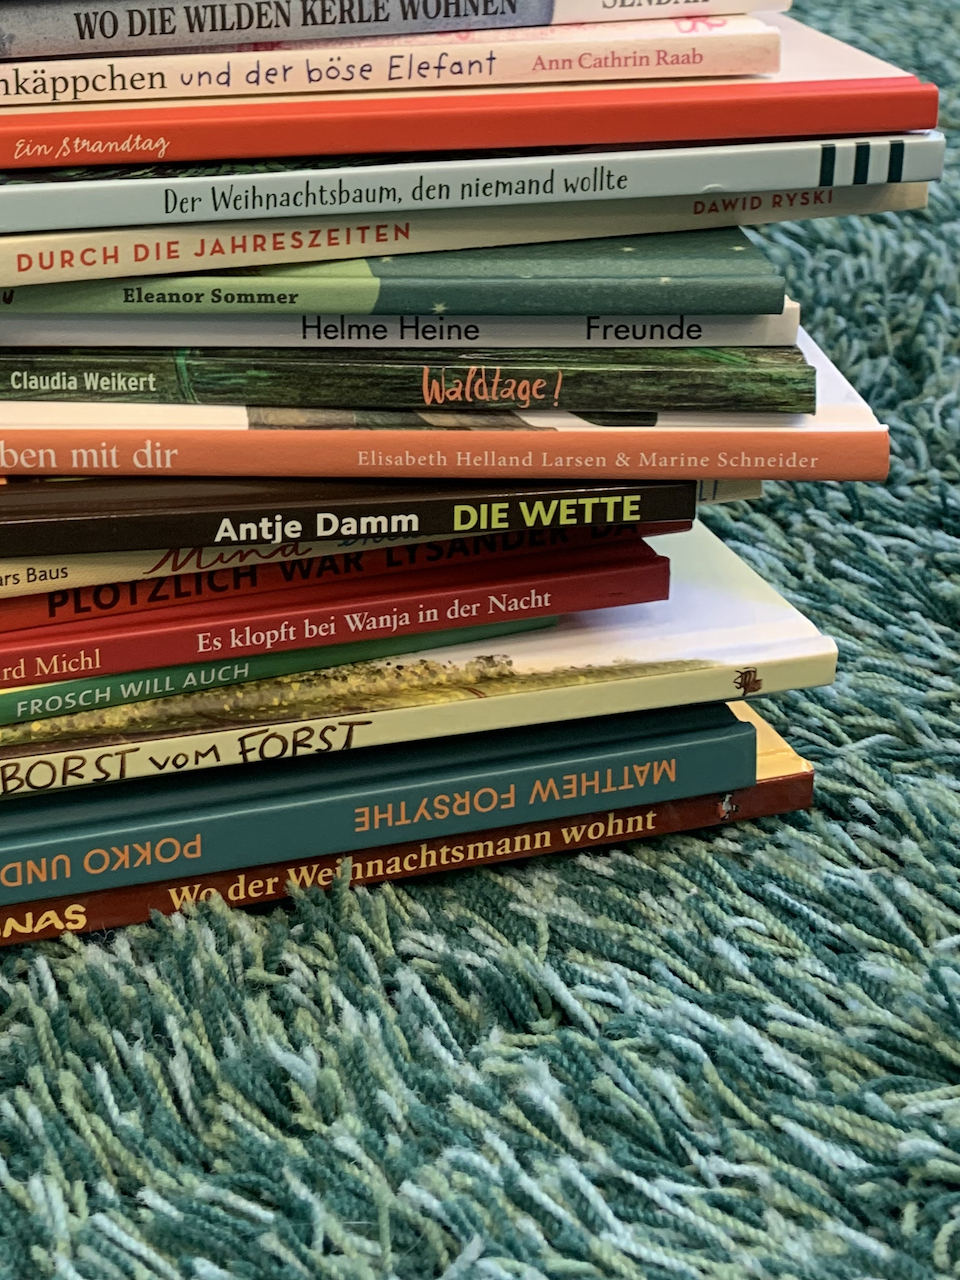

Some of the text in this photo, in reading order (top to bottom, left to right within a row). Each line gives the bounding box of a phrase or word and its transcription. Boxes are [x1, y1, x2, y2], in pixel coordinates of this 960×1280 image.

[180, 61, 231, 88] und
[246, 63, 293, 86] der
[306, 55, 373, 83] böse
[387, 51, 497, 81] Elefant
[532, 47, 703, 71] Ann Cathrin Raab
[165, 170, 629, 215] Der Weihnachtsbaum, den niemand wollte
[693, 189, 834, 215] DAWID RYSKI
[123, 287, 299, 306] Eleanor Sommer
[301, 316, 480, 341] Helme Heine
[586, 316, 703, 341] Freunde
[10, 371, 78, 391] Claudia
[83, 372, 156, 392] Weikert
[72, 441, 120, 469] mit
[133, 439, 179, 469] dir
[357, 451, 819, 470] Elisabeth Helland Larsen & Marine Schneider
[214, 512, 419, 545] Antje Damm
[26, 565, 68, 583] Baus
[35, 650, 102, 677] Michl
[354, 759, 676, 832] MATTHEW FORSYTHE
